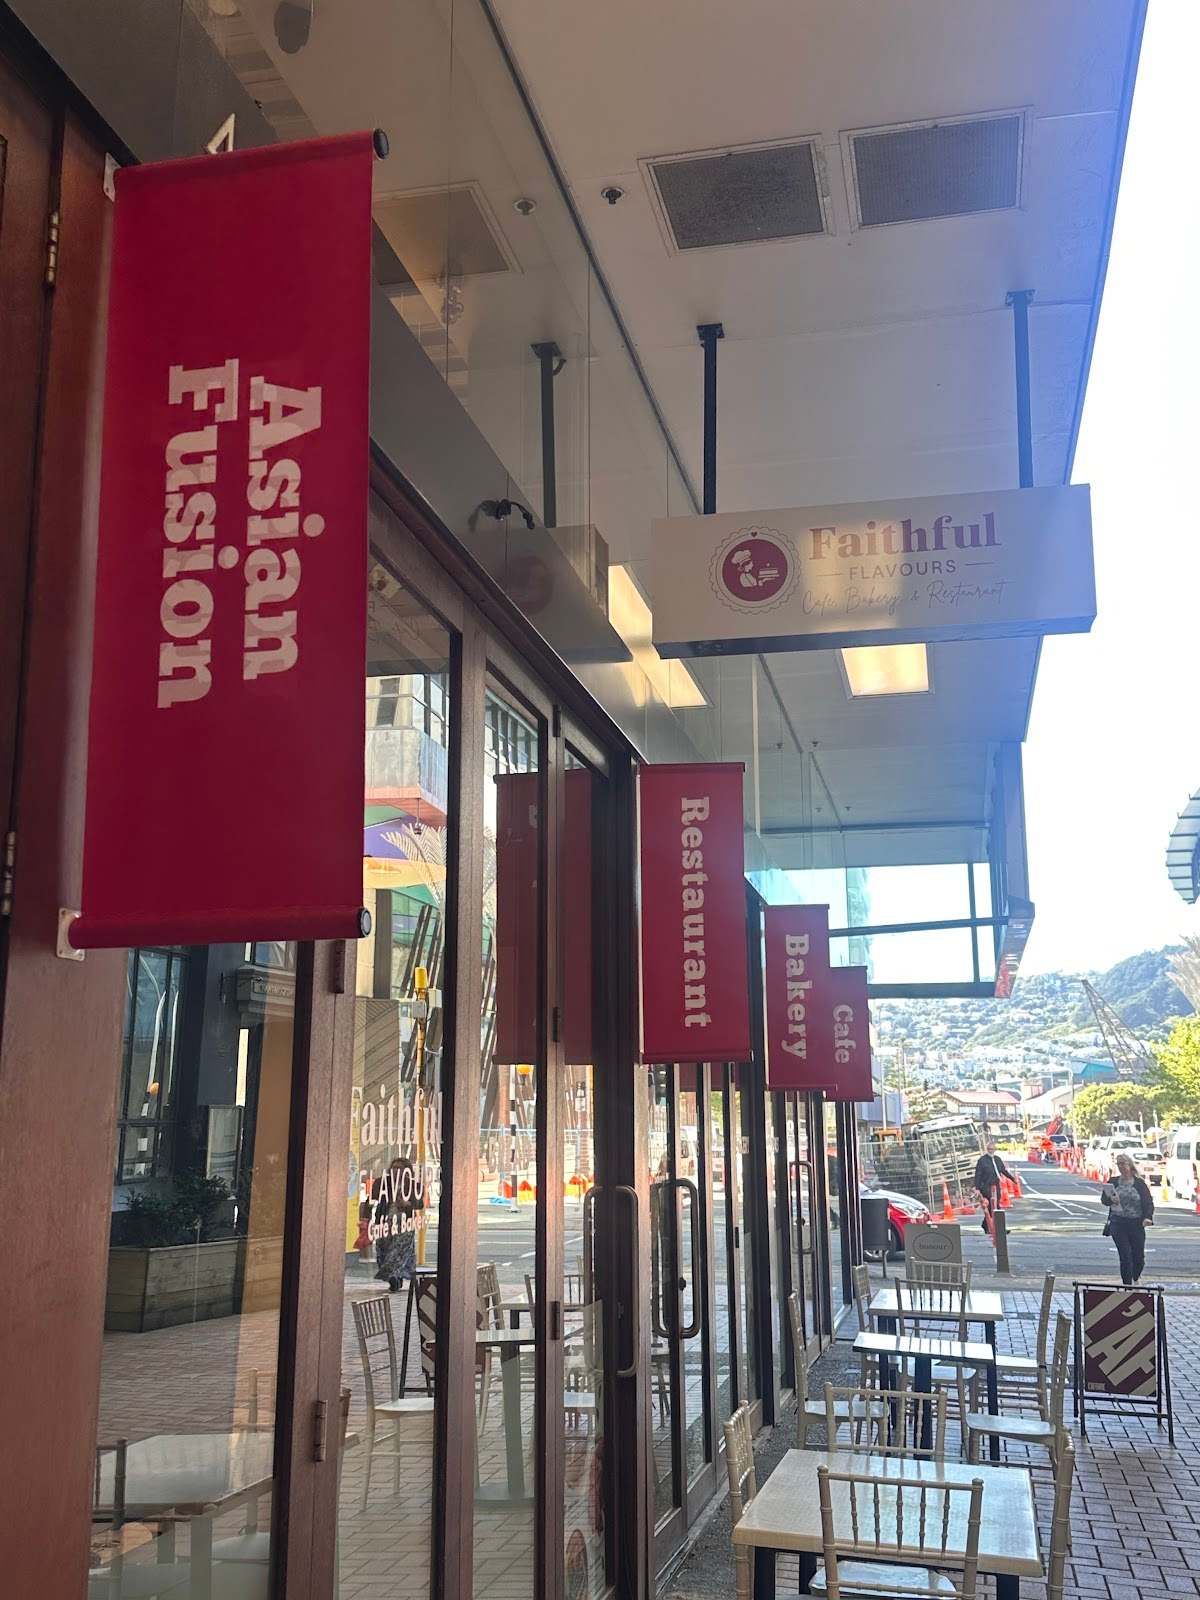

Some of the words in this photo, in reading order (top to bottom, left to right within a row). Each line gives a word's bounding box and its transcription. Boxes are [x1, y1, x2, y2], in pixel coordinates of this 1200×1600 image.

[157, 358, 240, 708] Fusion
[243, 376, 325, 680] Asian
[808, 512, 1002, 560] Faithful
[849, 560, 957, 580] FLAVOURS
[926, 579, 1016, 609] Restaurant
[680, 796, 712, 1028] Restaurant
[781, 933, 813, 1060] Bakery
[833, 1003, 857, 1064] Cafe
[351, 1084, 444, 1146] Faithful
[368, 1215, 389, 1241] Café
[391, 1214, 399, 1235] &
